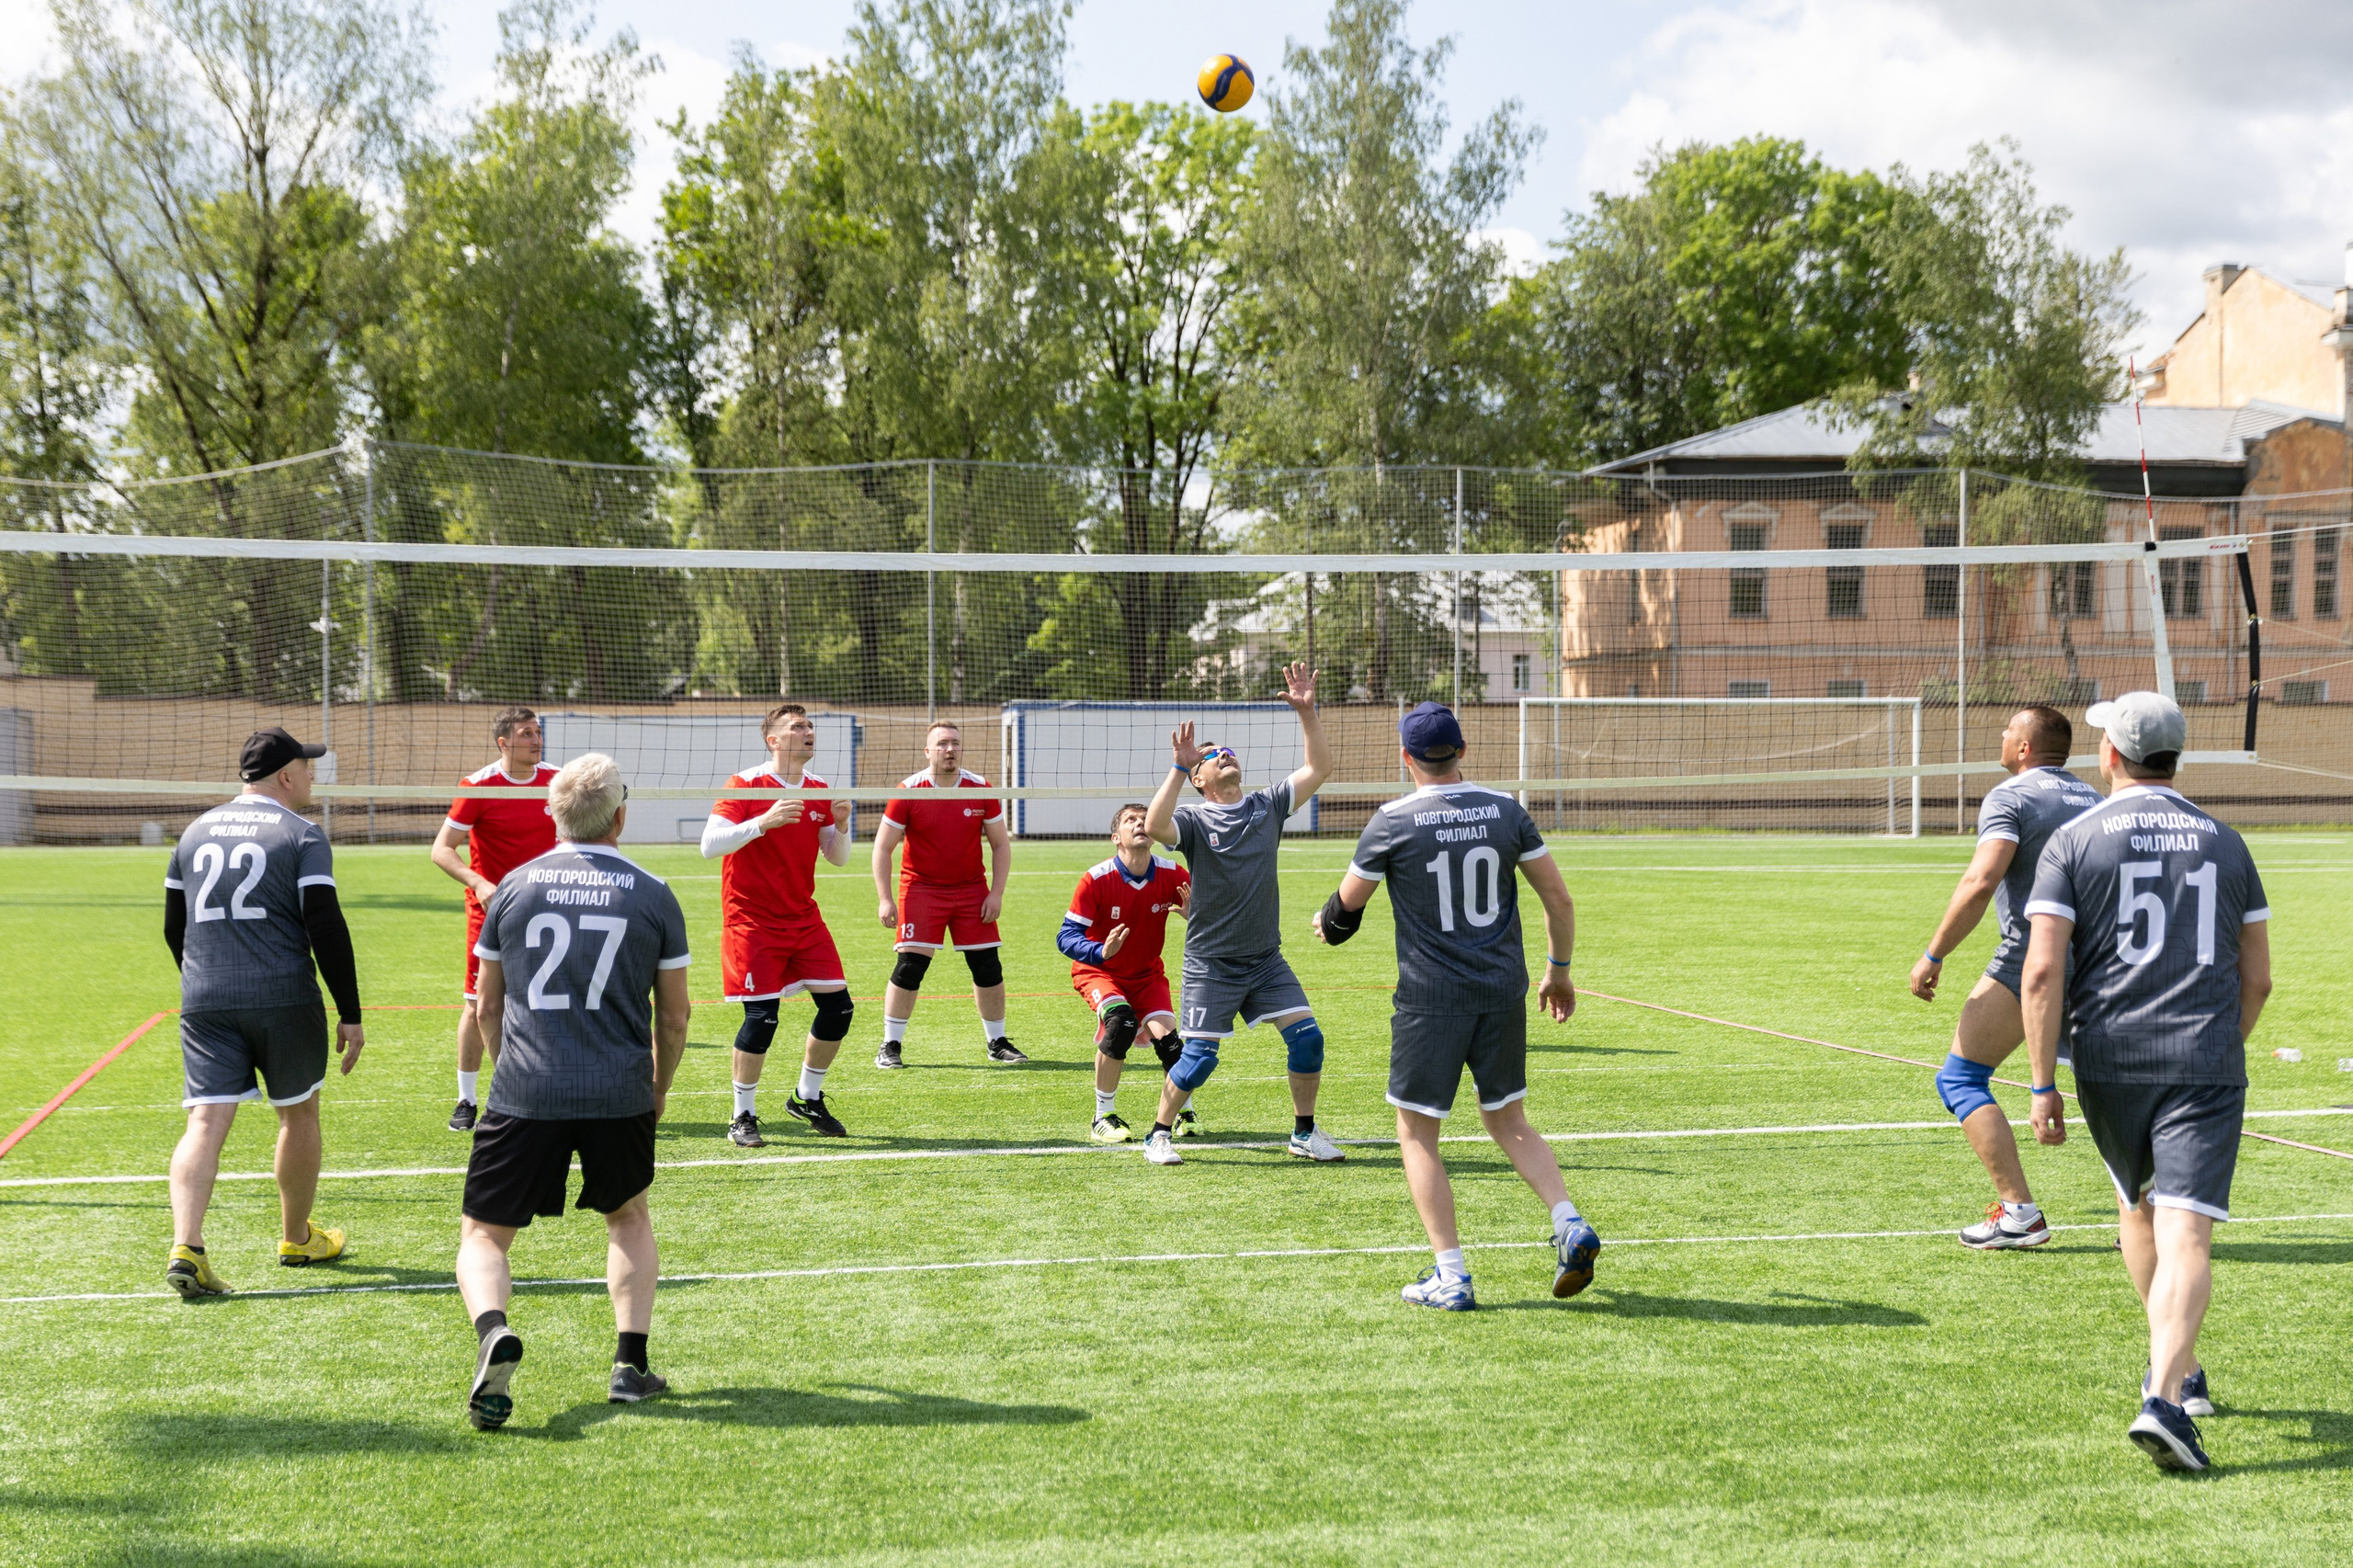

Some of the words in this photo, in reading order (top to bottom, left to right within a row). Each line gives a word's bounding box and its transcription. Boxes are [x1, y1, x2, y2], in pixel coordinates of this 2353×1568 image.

[1414, 803, 1501, 827] НОВГОРОДСКИЙ
[2101, 812, 2219, 835] НОВГОРОДСКИЙ
[209, 824, 258, 837] ФИЛИАЛ
[1435, 824, 1488, 843] ФИЛИАЛ
[2131, 834, 2200, 852] ФИЛИАЛ
[192, 842, 267, 924] 22
[527, 869, 635, 890] НОВГОРОДСКИЙ
[1427, 846, 1500, 932] 10
[546, 889, 610, 907] ФИЛИАЛ
[2116, 860, 2218, 966] 51
[901, 923, 915, 939] 13
[525, 913, 628, 1011] 27
[745, 972, 755, 993] 4
[1091, 988, 1102, 1004] 8
[1188, 1006, 1208, 1028] 17
